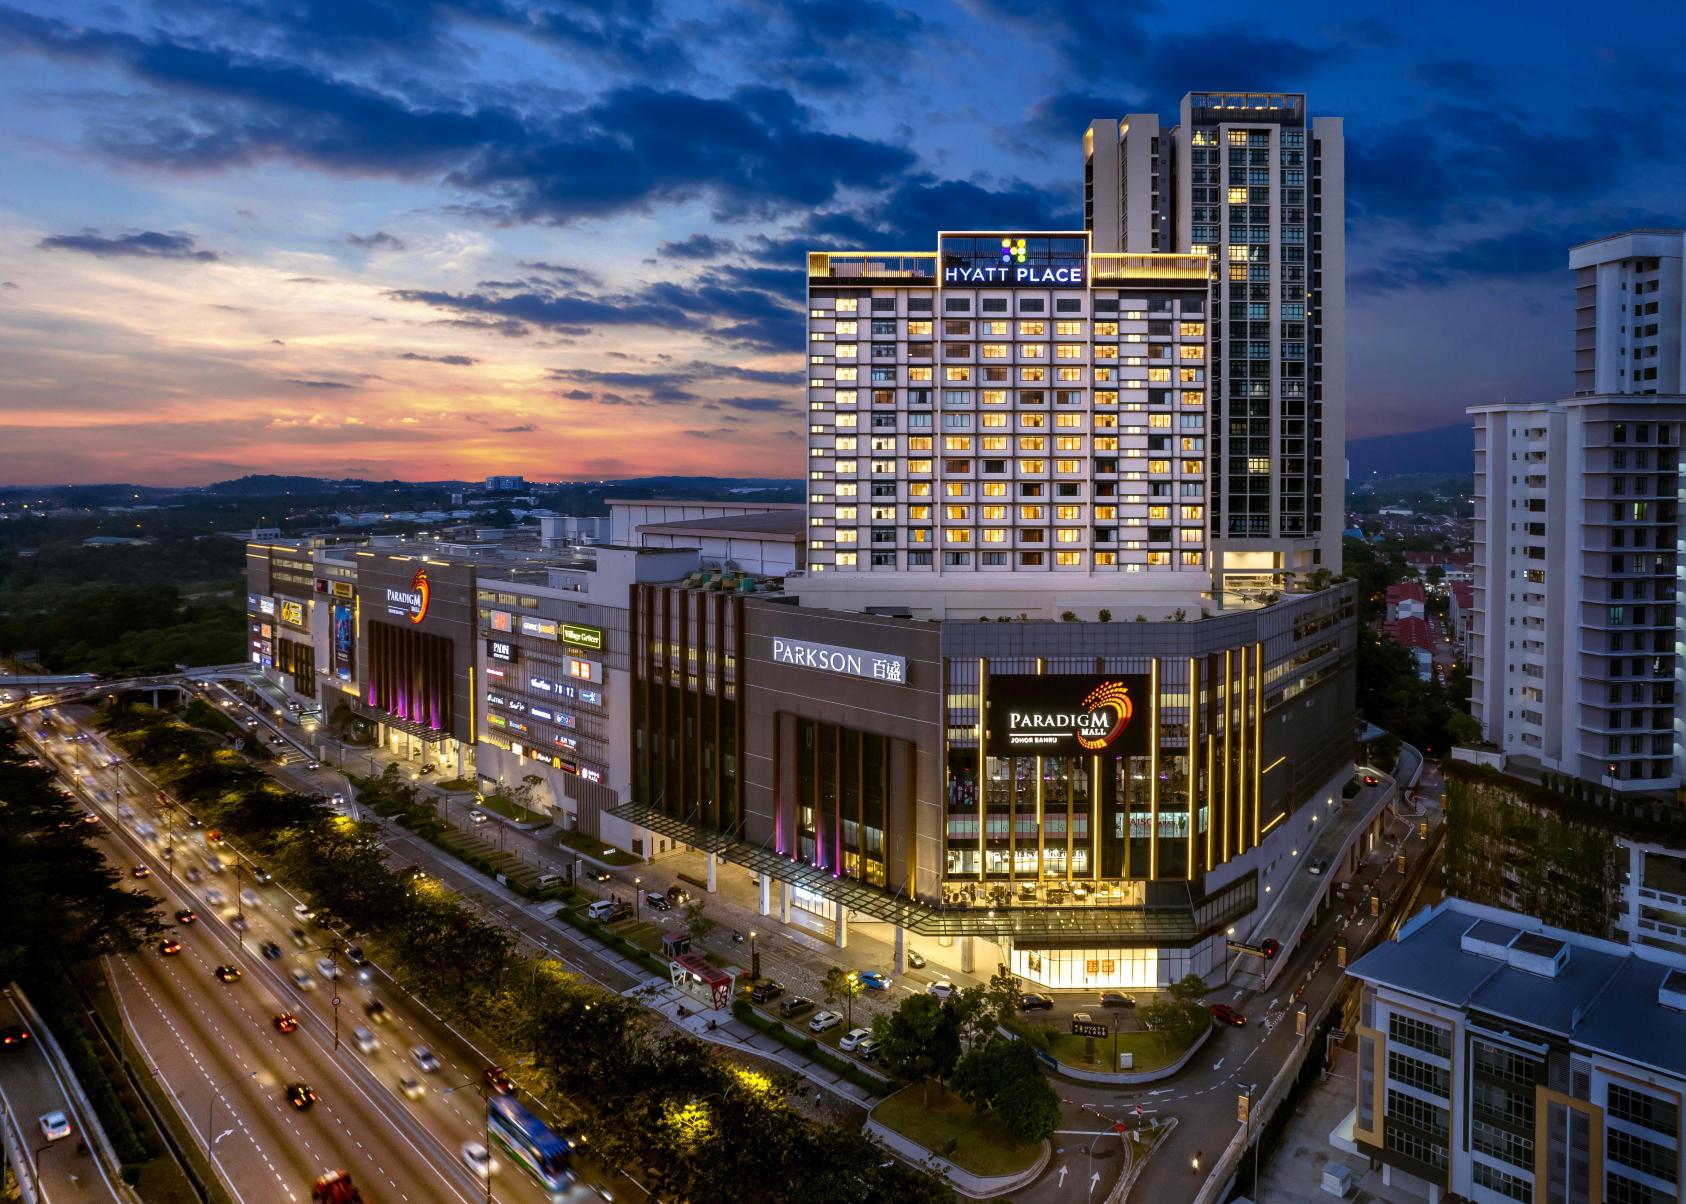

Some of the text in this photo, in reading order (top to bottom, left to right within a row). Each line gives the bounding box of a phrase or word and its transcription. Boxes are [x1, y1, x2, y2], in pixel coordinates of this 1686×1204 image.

[945, 267, 1082, 282] HYATT PLACE
[386, 588, 421, 607] PARADIGM
[773, 640, 902, 682] PARKSON 百盛
[1009, 712, 1110, 729] PARADIGM
[1010, 736, 1058, 744] JOHOR BAHRU
[1081, 728, 1107, 736] MALL
